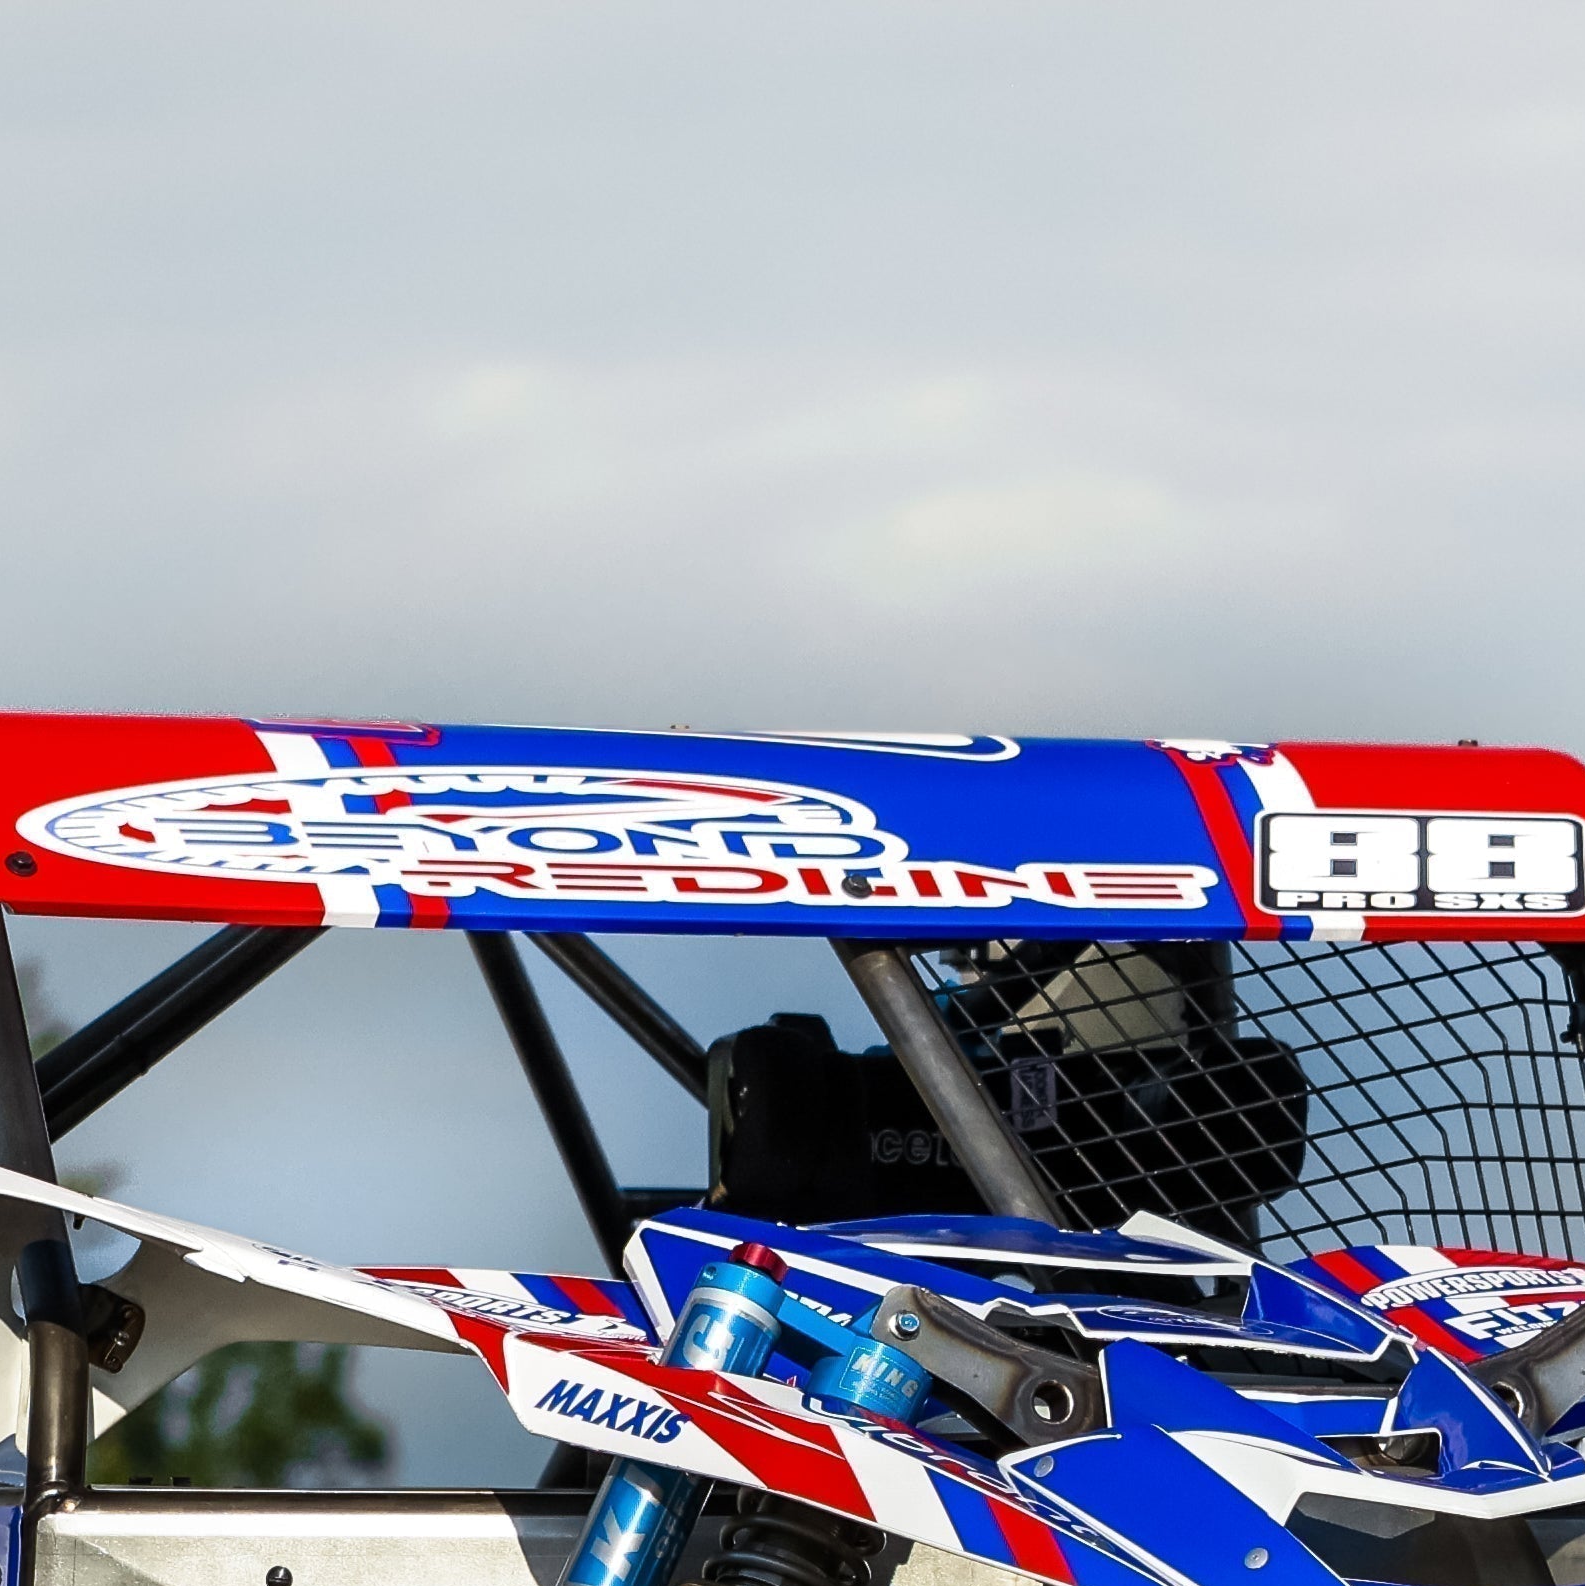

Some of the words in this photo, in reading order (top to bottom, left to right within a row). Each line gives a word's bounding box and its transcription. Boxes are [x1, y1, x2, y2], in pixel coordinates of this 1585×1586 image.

[399, 859, 1209, 902] REDLINE
[1268, 815, 1578, 893] 88
[1276, 892, 1416, 909] PRO
[1434, 893, 1570, 910] SXS
[533, 1379, 691, 1445] MAXXIS
